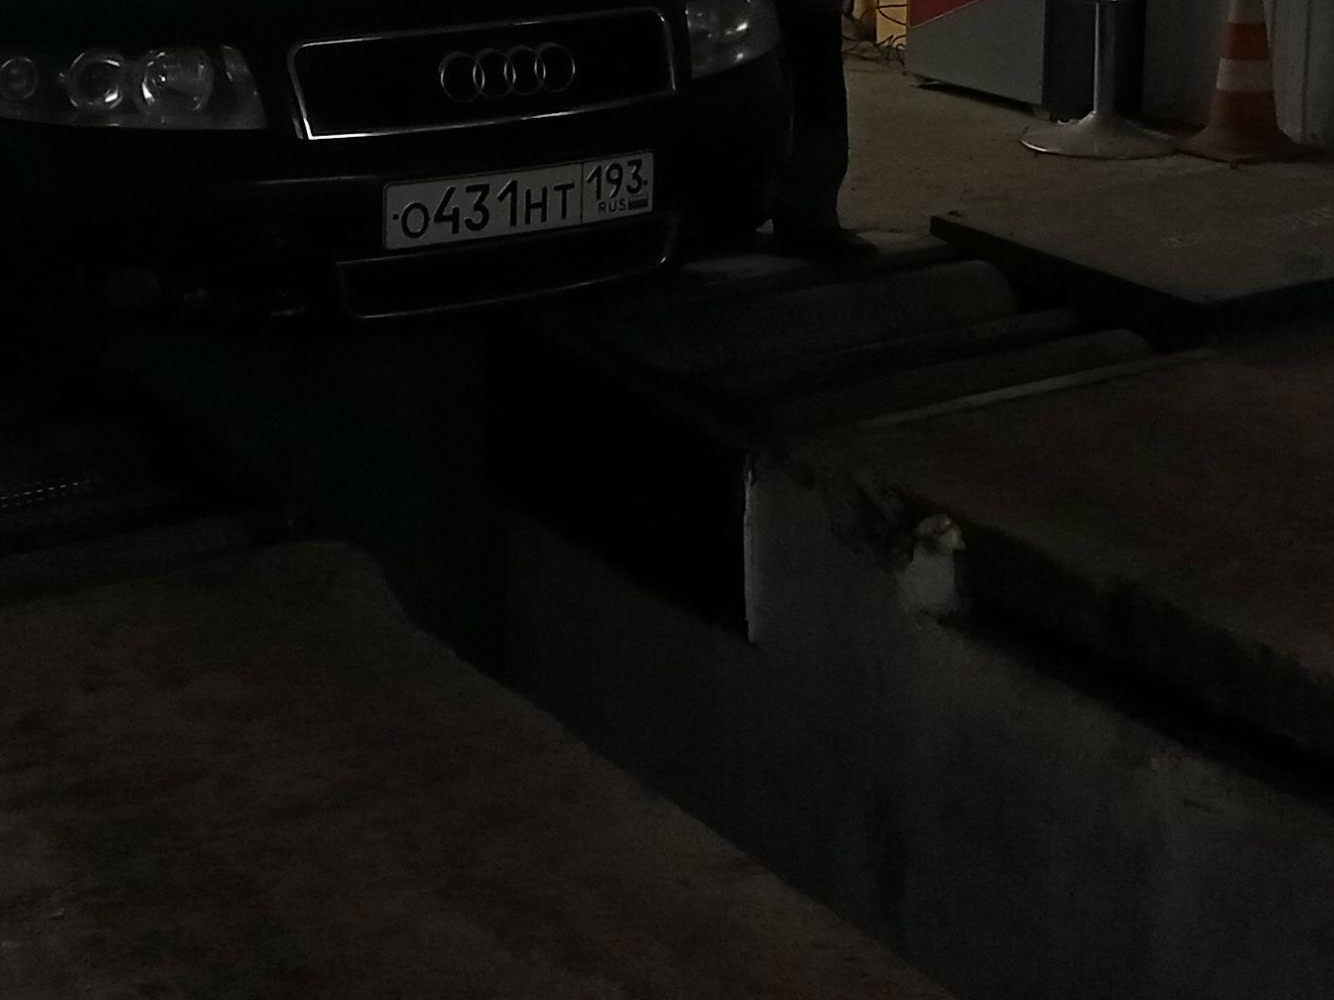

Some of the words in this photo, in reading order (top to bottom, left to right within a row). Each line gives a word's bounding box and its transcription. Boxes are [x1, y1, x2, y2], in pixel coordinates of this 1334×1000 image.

[401, 179, 575, 239] О431НТ
[585, 159, 643, 201] 193
[598, 200, 627, 214] RUS
